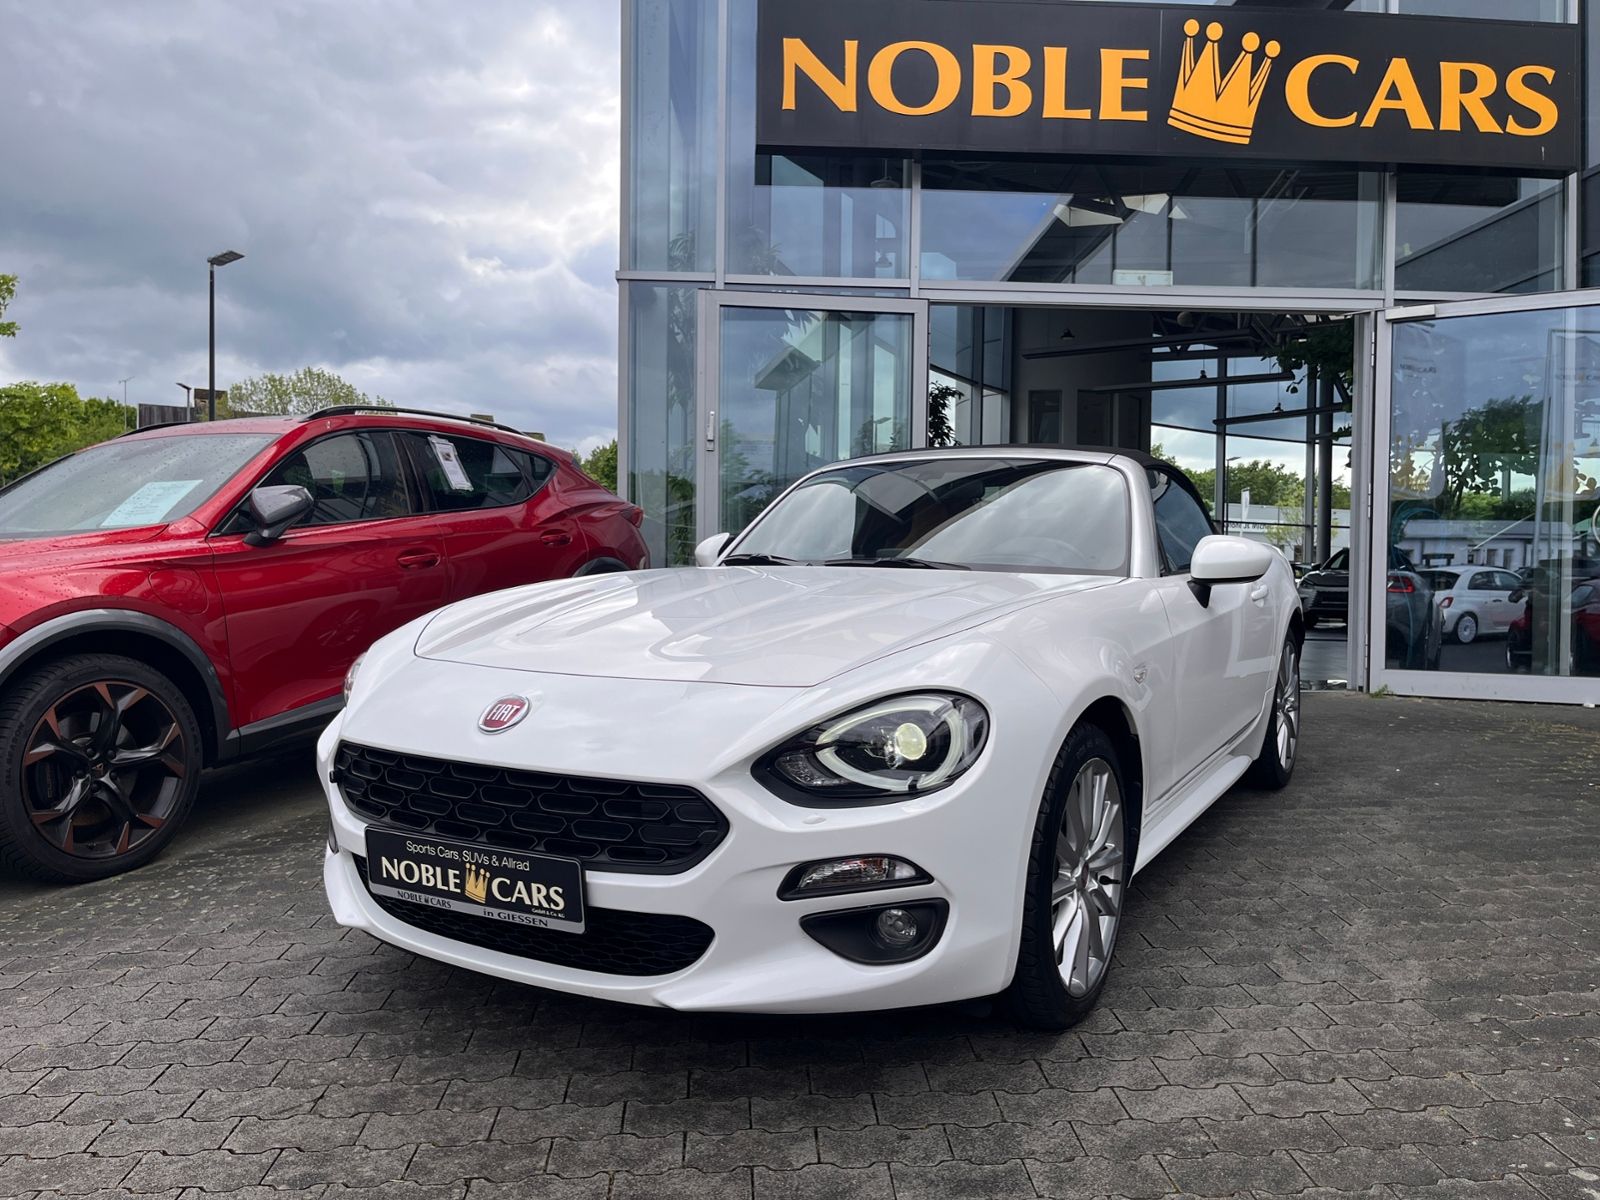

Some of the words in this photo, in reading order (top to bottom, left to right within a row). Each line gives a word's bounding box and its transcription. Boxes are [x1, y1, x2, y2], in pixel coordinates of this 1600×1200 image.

[782, 38, 1150, 121] NOBLE
[1285, 53, 1558, 137] CARS
[486, 704, 520, 721] FIAT
[406, 840, 436, 856] Sports
[437, 846, 462, 861] Cars,
[463, 850, 490, 865] SUVs
[491, 855, 500, 866] &
[501, 856, 530, 871] Allrad
[381, 856, 461, 892] NOBLE
[491, 878, 565, 910] CARS
[398, 891, 422, 902] NOBLE
[430, 897, 452, 908] CARS
[483, 908, 494, 917] in
[498, 912, 548, 927] GIESSEN
